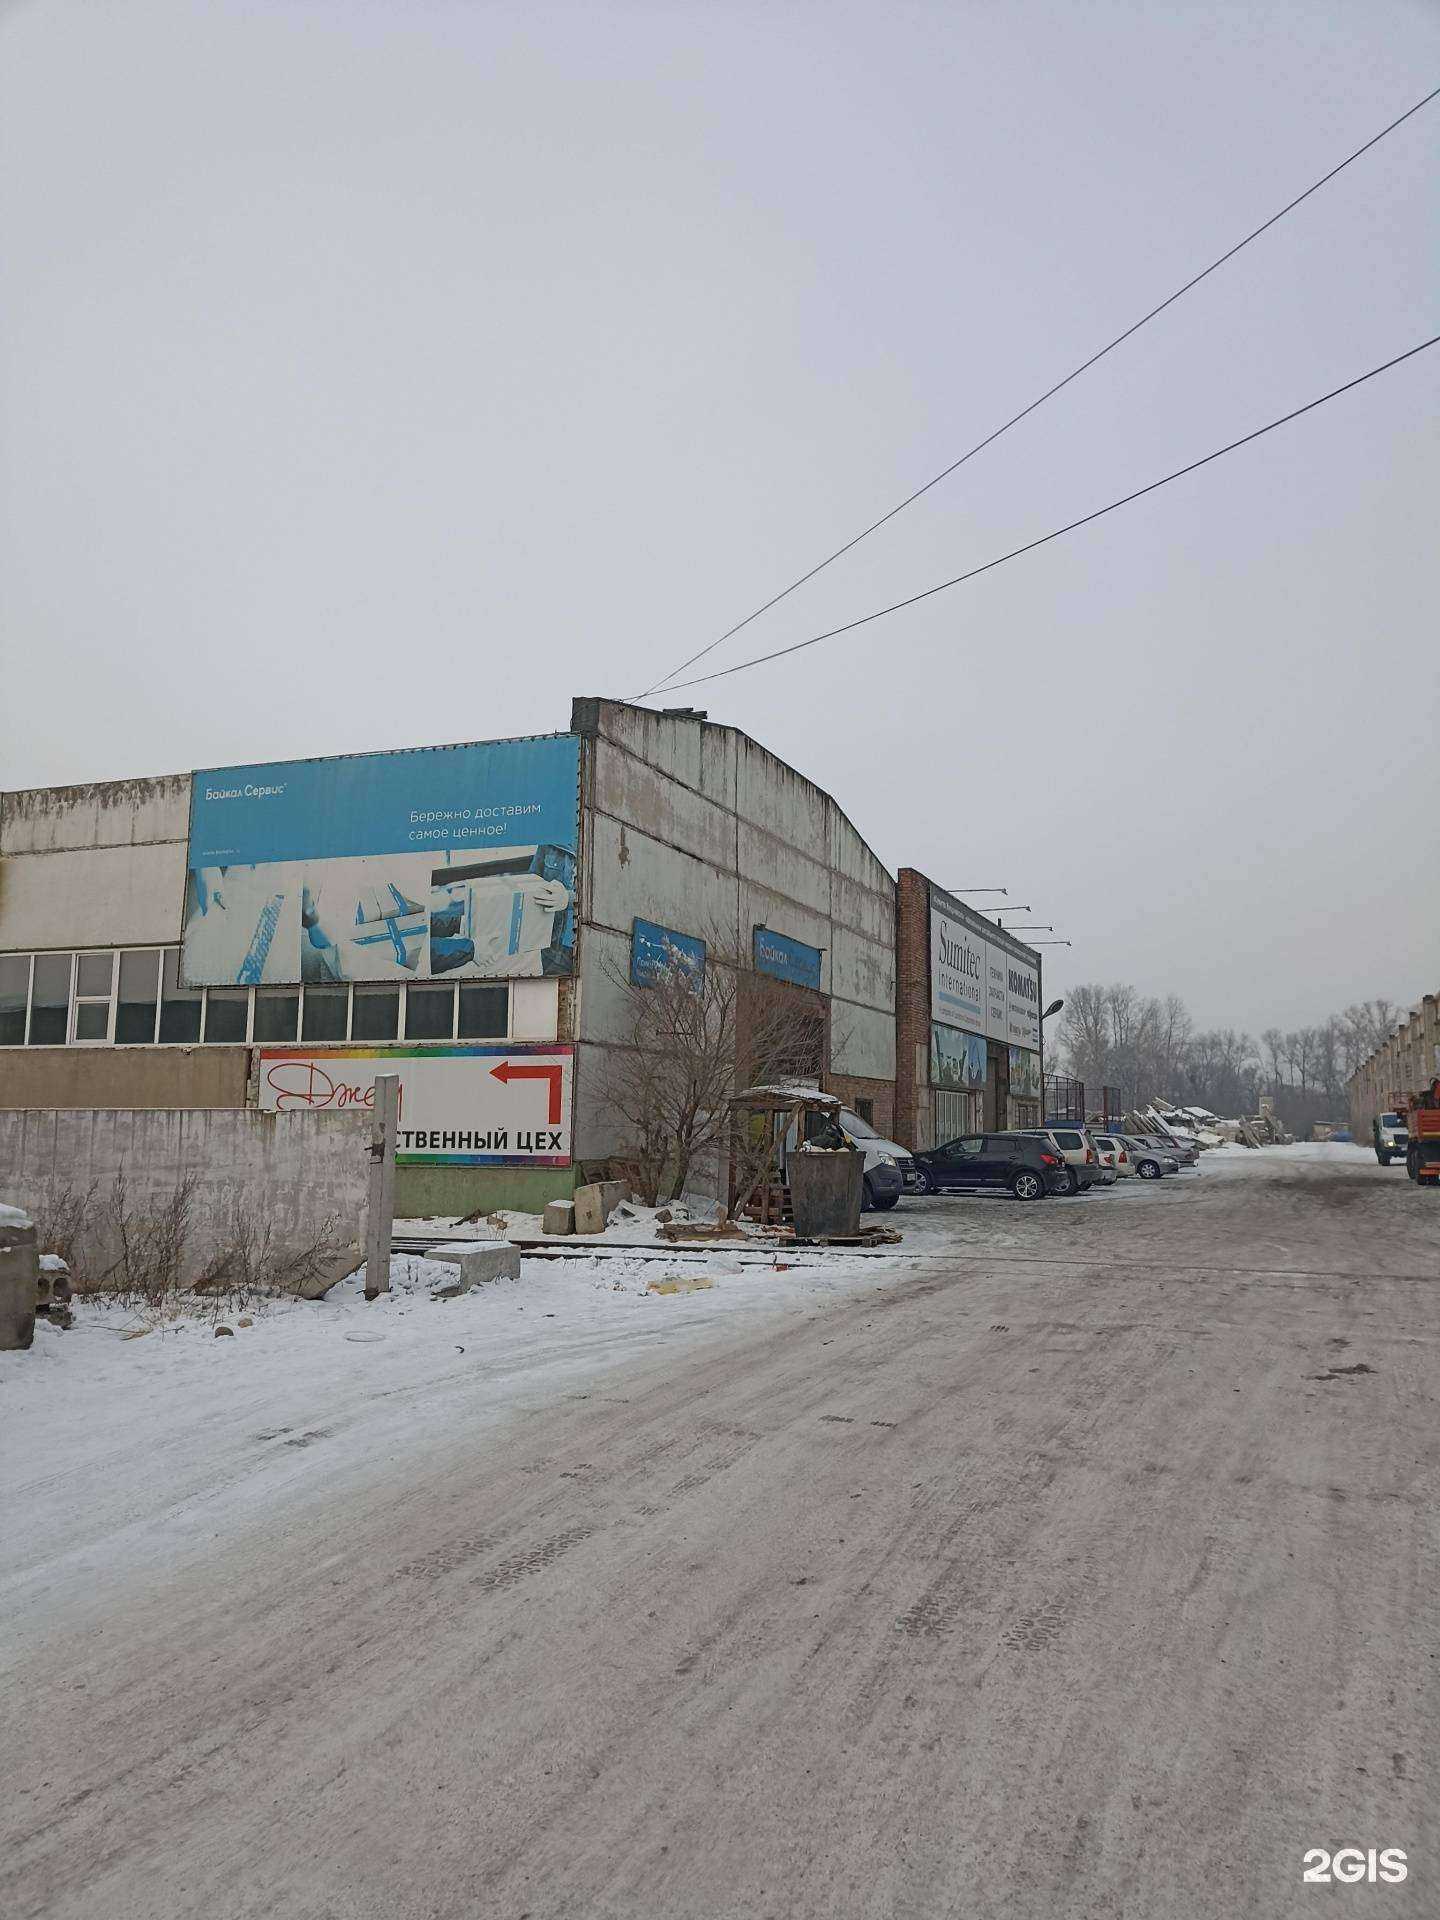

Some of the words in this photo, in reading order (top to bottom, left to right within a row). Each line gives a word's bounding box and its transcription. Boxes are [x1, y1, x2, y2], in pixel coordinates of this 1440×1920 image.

[205, 787, 242, 801] Байкал
[244, 784, 285, 799] Сервис
[410, 809, 471, 823] Бережно
[474, 803, 541, 820] доставим
[408, 829, 449, 841] самое
[453, 822, 507, 839] ценное!
[939, 920, 981, 980] Sumitec
[939, 968, 981, 1002] International
[267, 1062, 403, 1122] Дже
[516, 1131, 563, 1153] ЦЕХ
